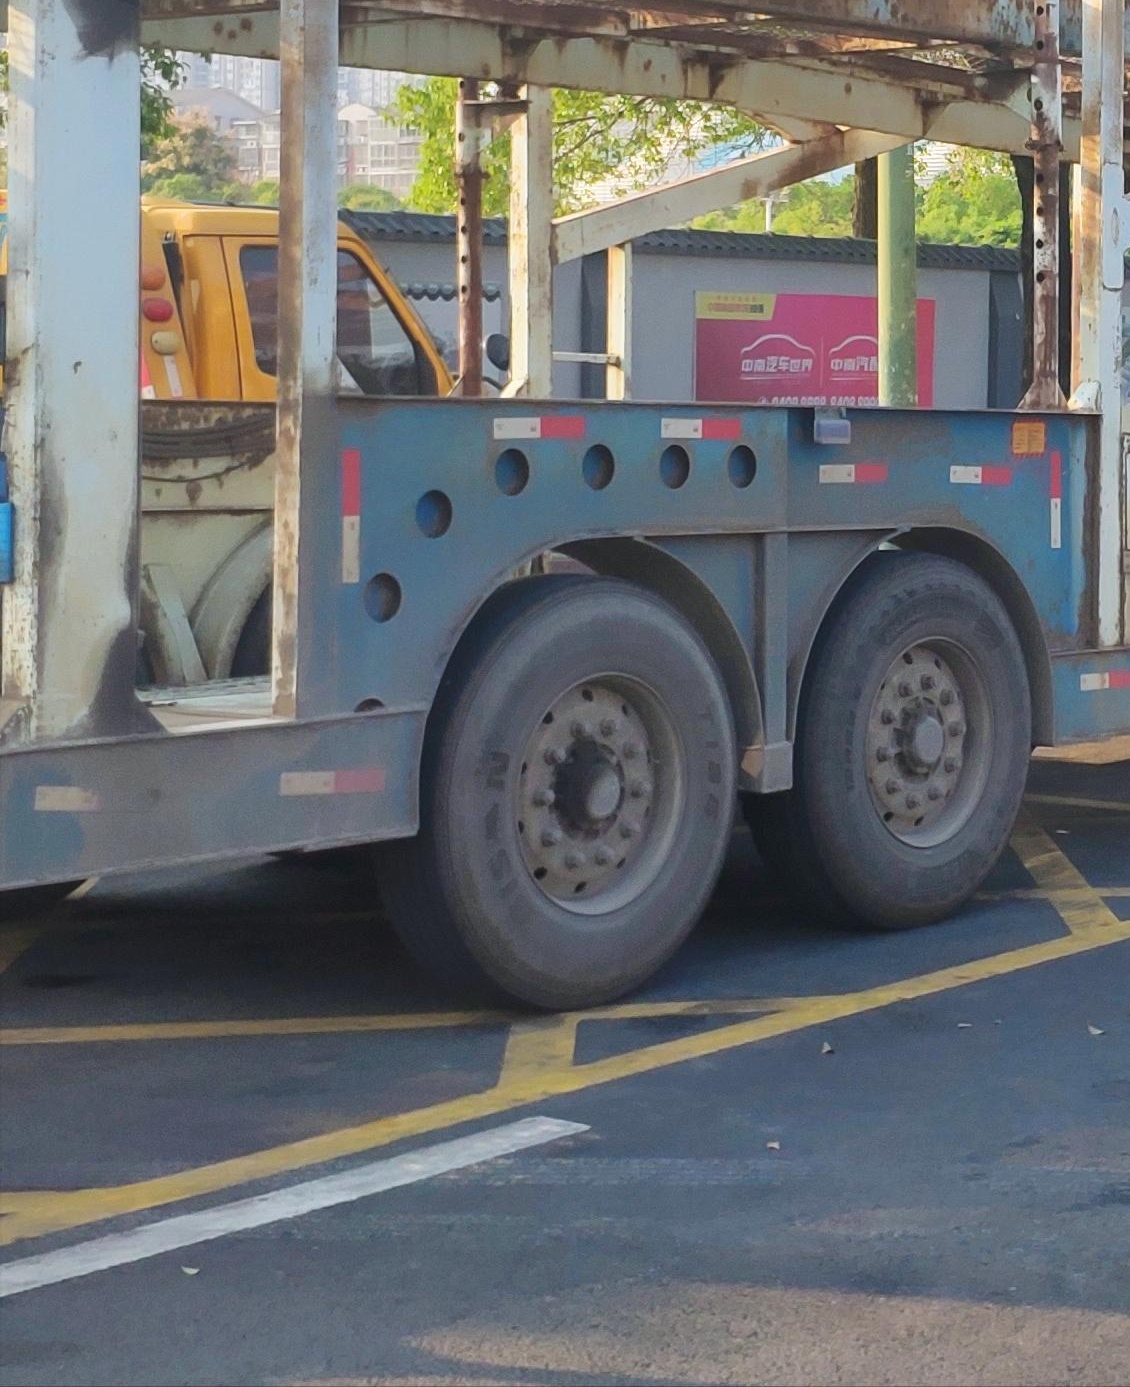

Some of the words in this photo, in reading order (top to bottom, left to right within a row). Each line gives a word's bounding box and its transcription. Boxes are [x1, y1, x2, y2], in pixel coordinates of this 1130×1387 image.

[741, 355, 813, 373] 中南汽车世界
